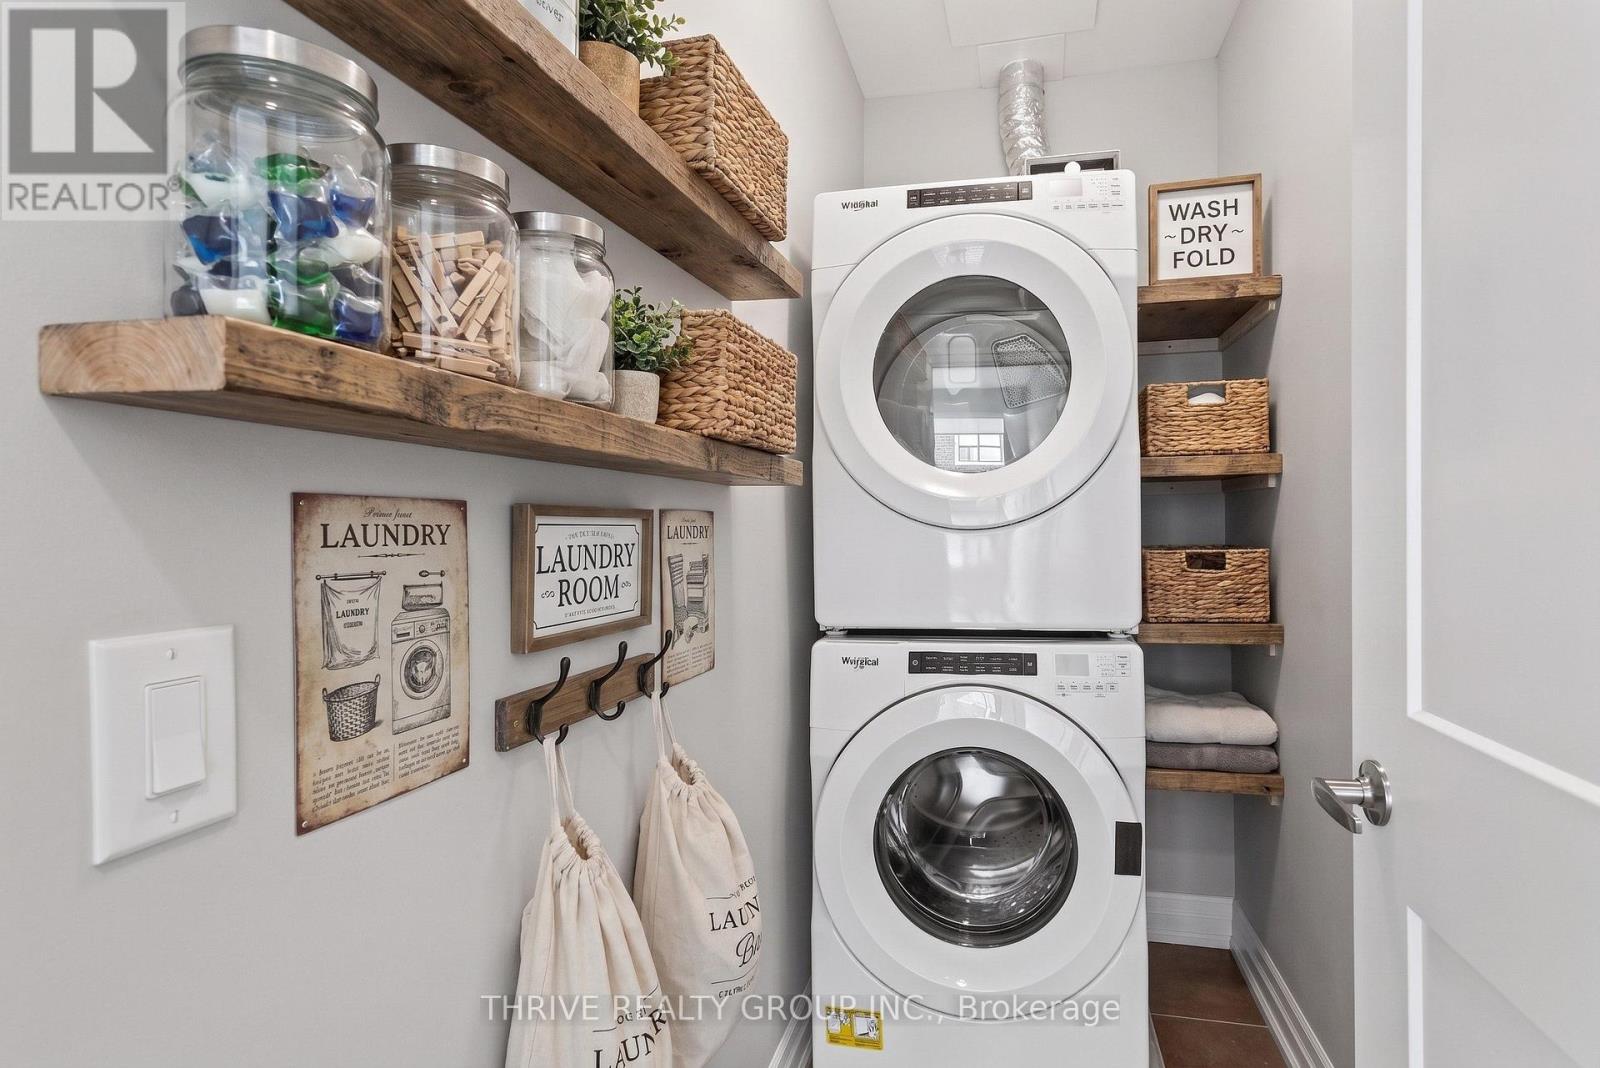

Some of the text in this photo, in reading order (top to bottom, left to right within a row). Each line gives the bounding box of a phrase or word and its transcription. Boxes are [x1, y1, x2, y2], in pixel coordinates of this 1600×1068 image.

[1168, 198, 1239, 222] WASH
[1173, 247, 1236, 269] FOLD
[320, 523, 451, 549] LAUNDRY
[667, 525, 710, 540] LAUNDRY
[536, 543, 636, 575] LAUNDRY
[557, 574, 620, 608] ROOM
[335, 607, 370, 619] LAUNDRY
